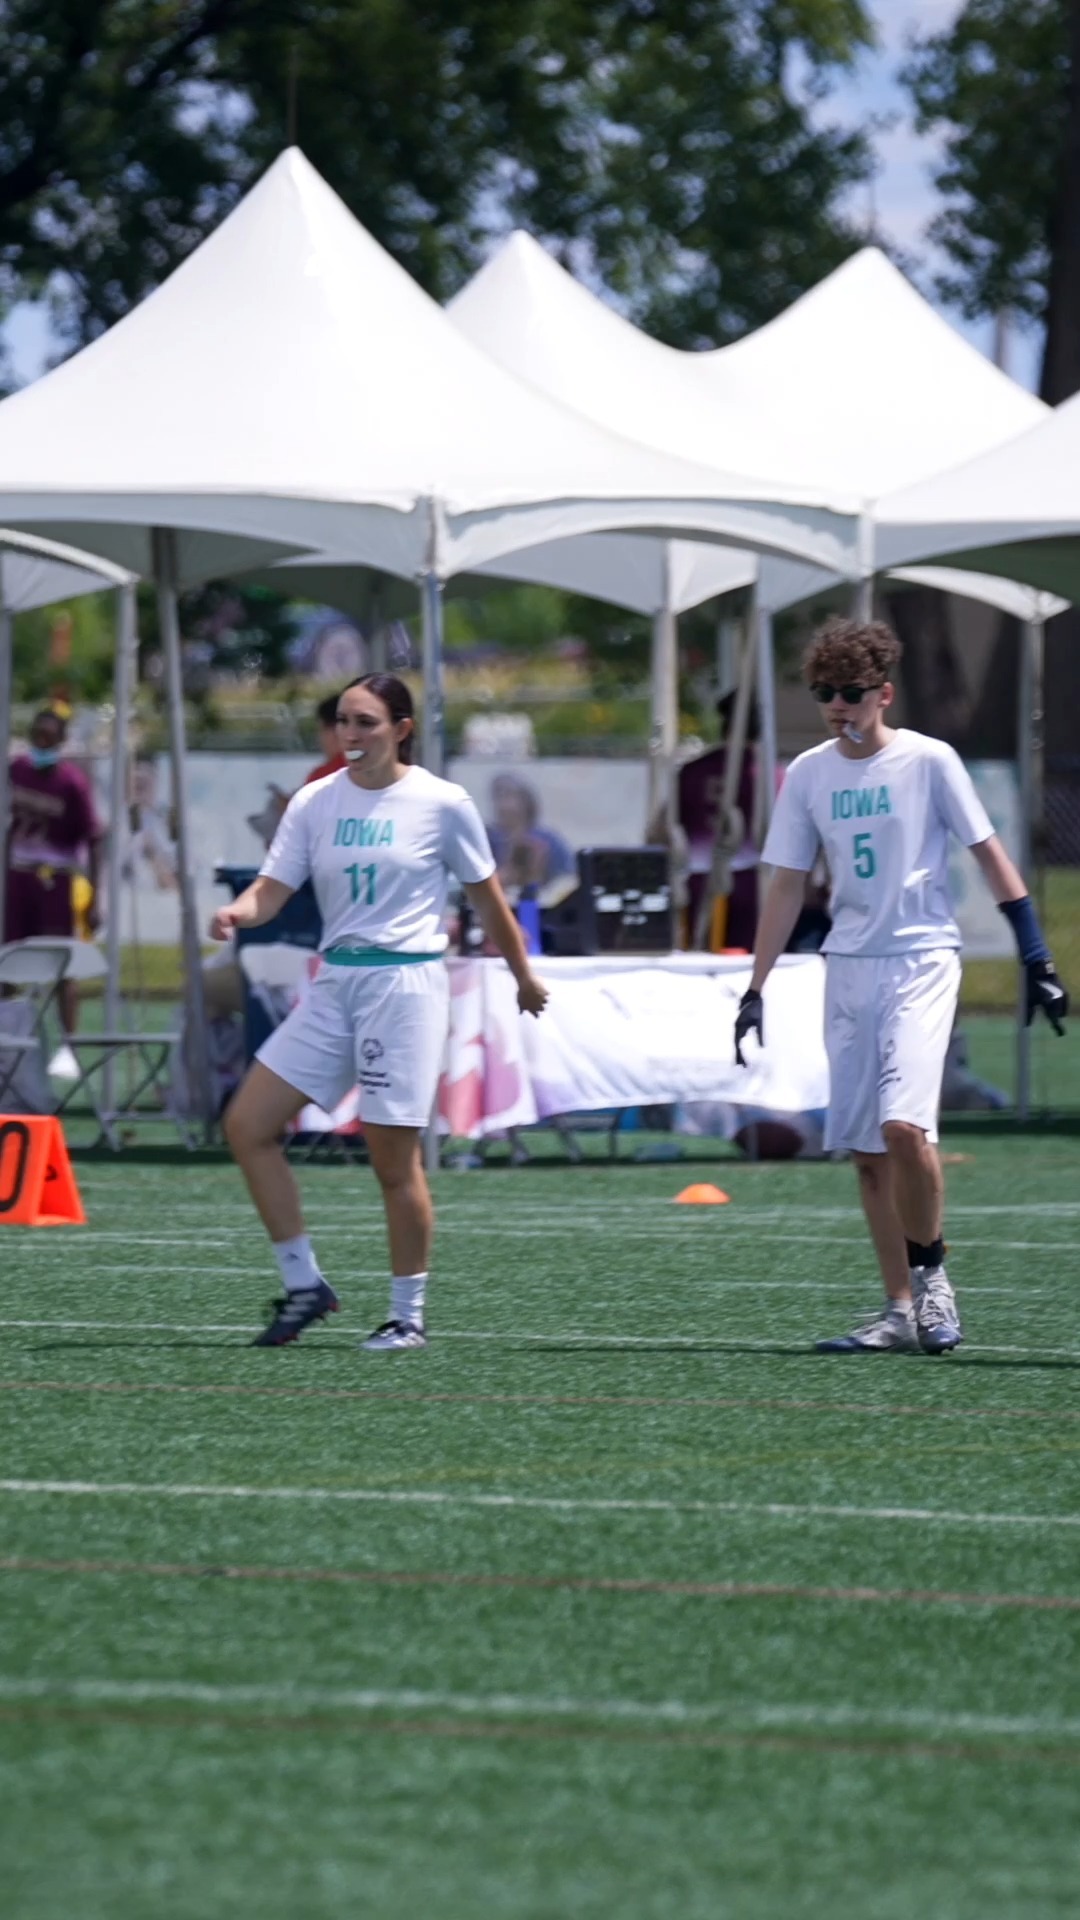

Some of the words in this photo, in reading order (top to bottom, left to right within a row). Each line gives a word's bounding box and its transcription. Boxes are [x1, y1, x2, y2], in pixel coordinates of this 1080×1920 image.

[831, 784, 891, 821] IOWA
[332, 817, 394, 848] IOWA
[853, 832, 876, 880] 5
[343, 862, 377, 906] 11
[0, 1121, 30, 1213] 0
